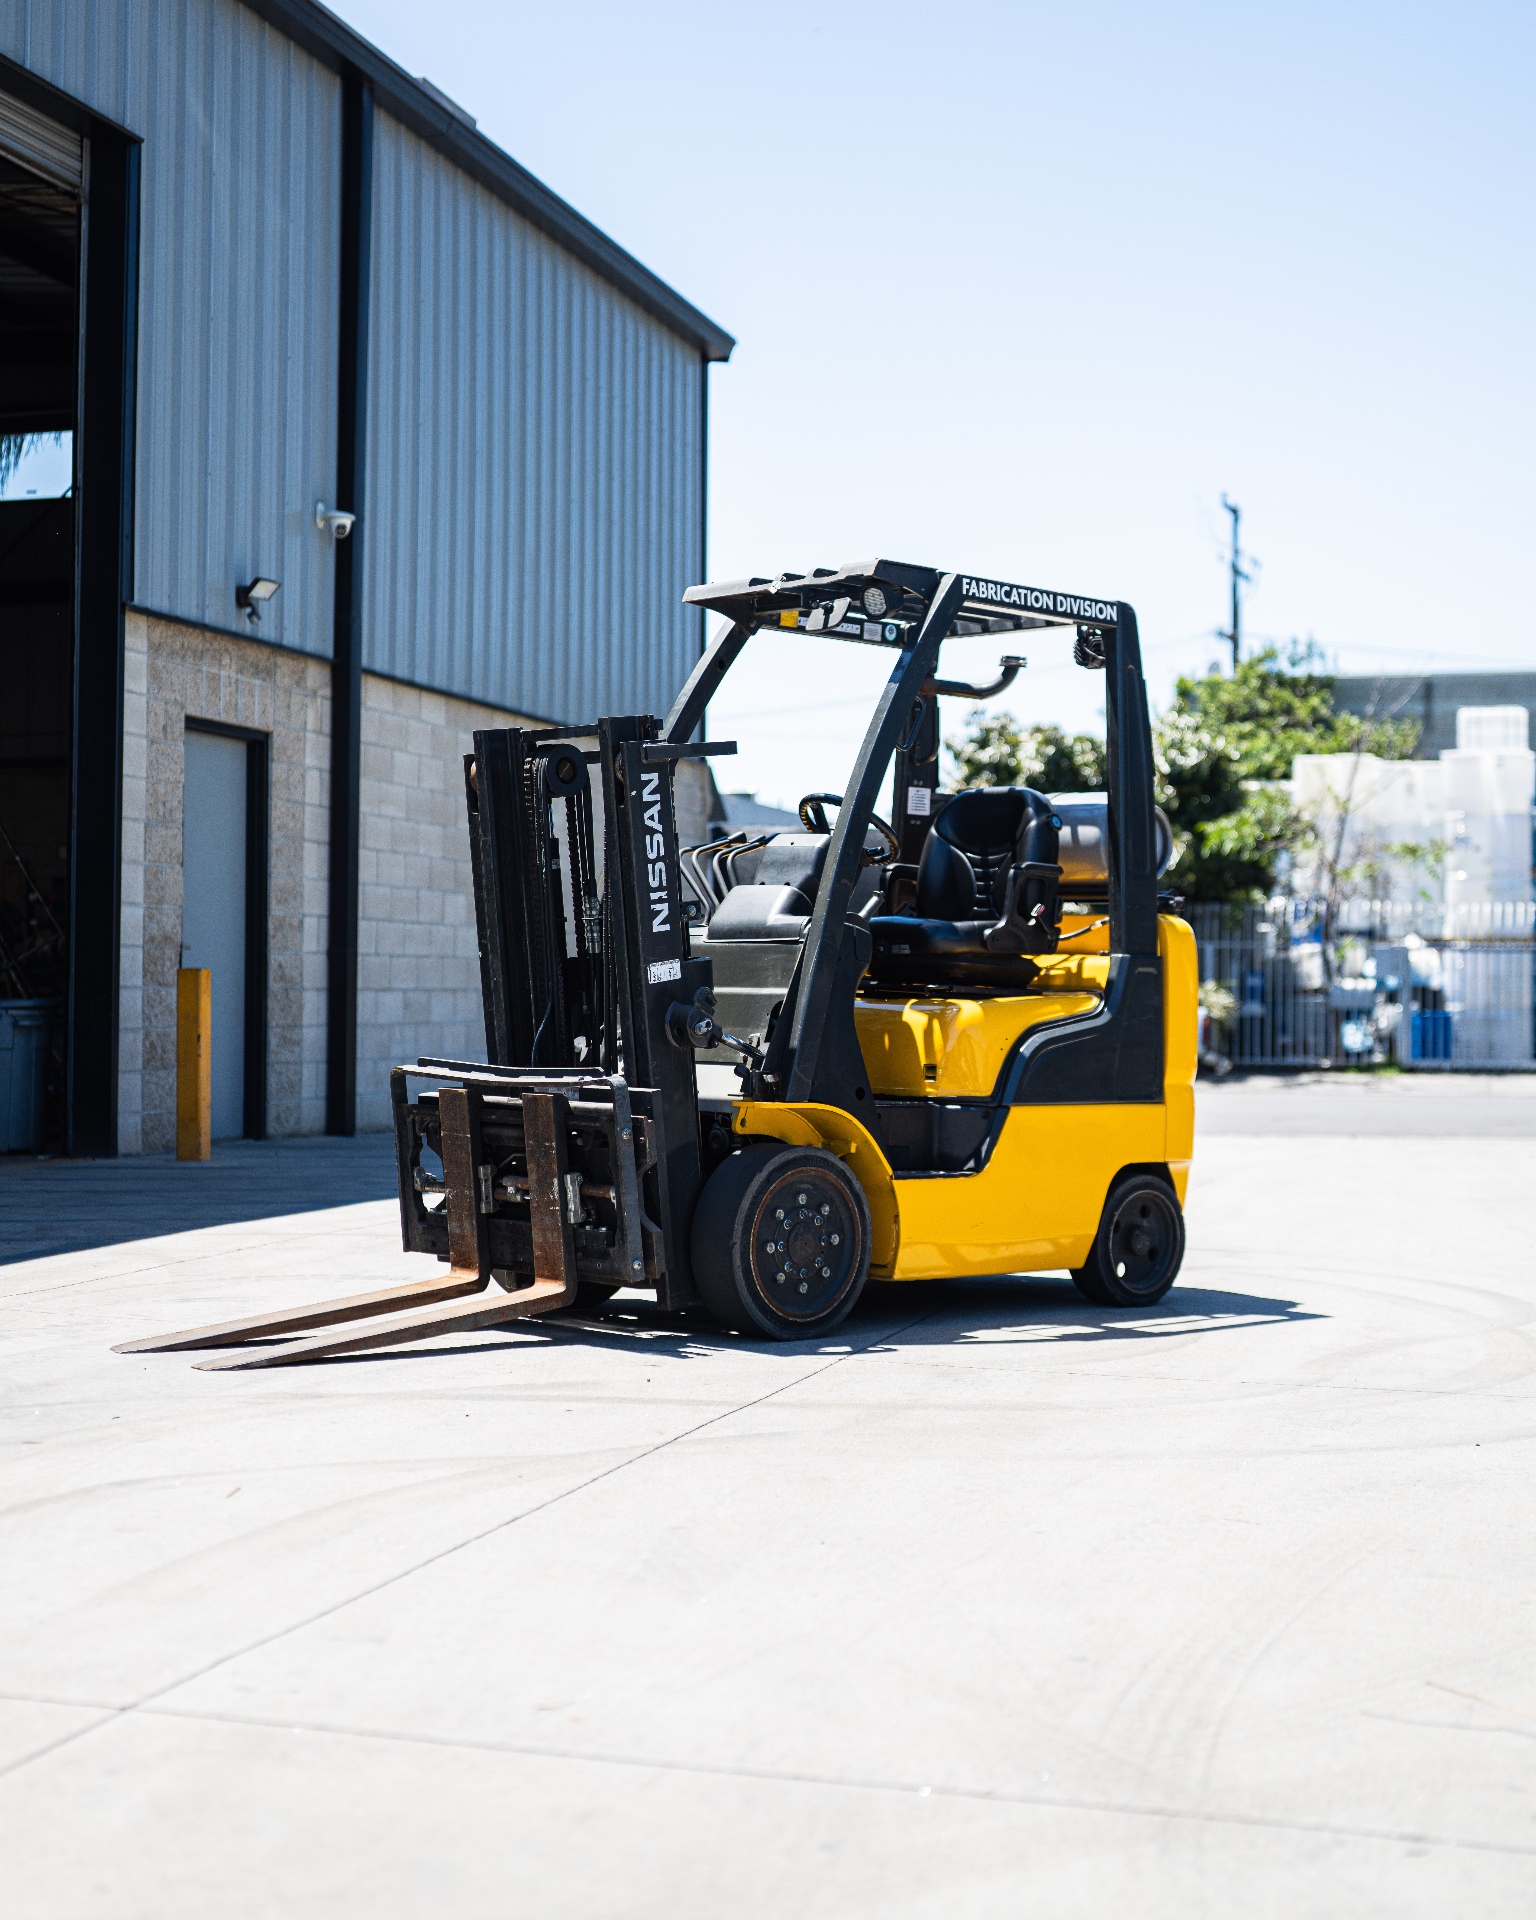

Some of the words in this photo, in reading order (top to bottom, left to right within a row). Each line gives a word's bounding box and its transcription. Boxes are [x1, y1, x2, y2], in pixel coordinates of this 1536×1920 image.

[962, 578, 1053, 610] FABRICATION
[1057, 596, 1118, 621] DIVISION
[641, 772, 671, 932] NISSAN
